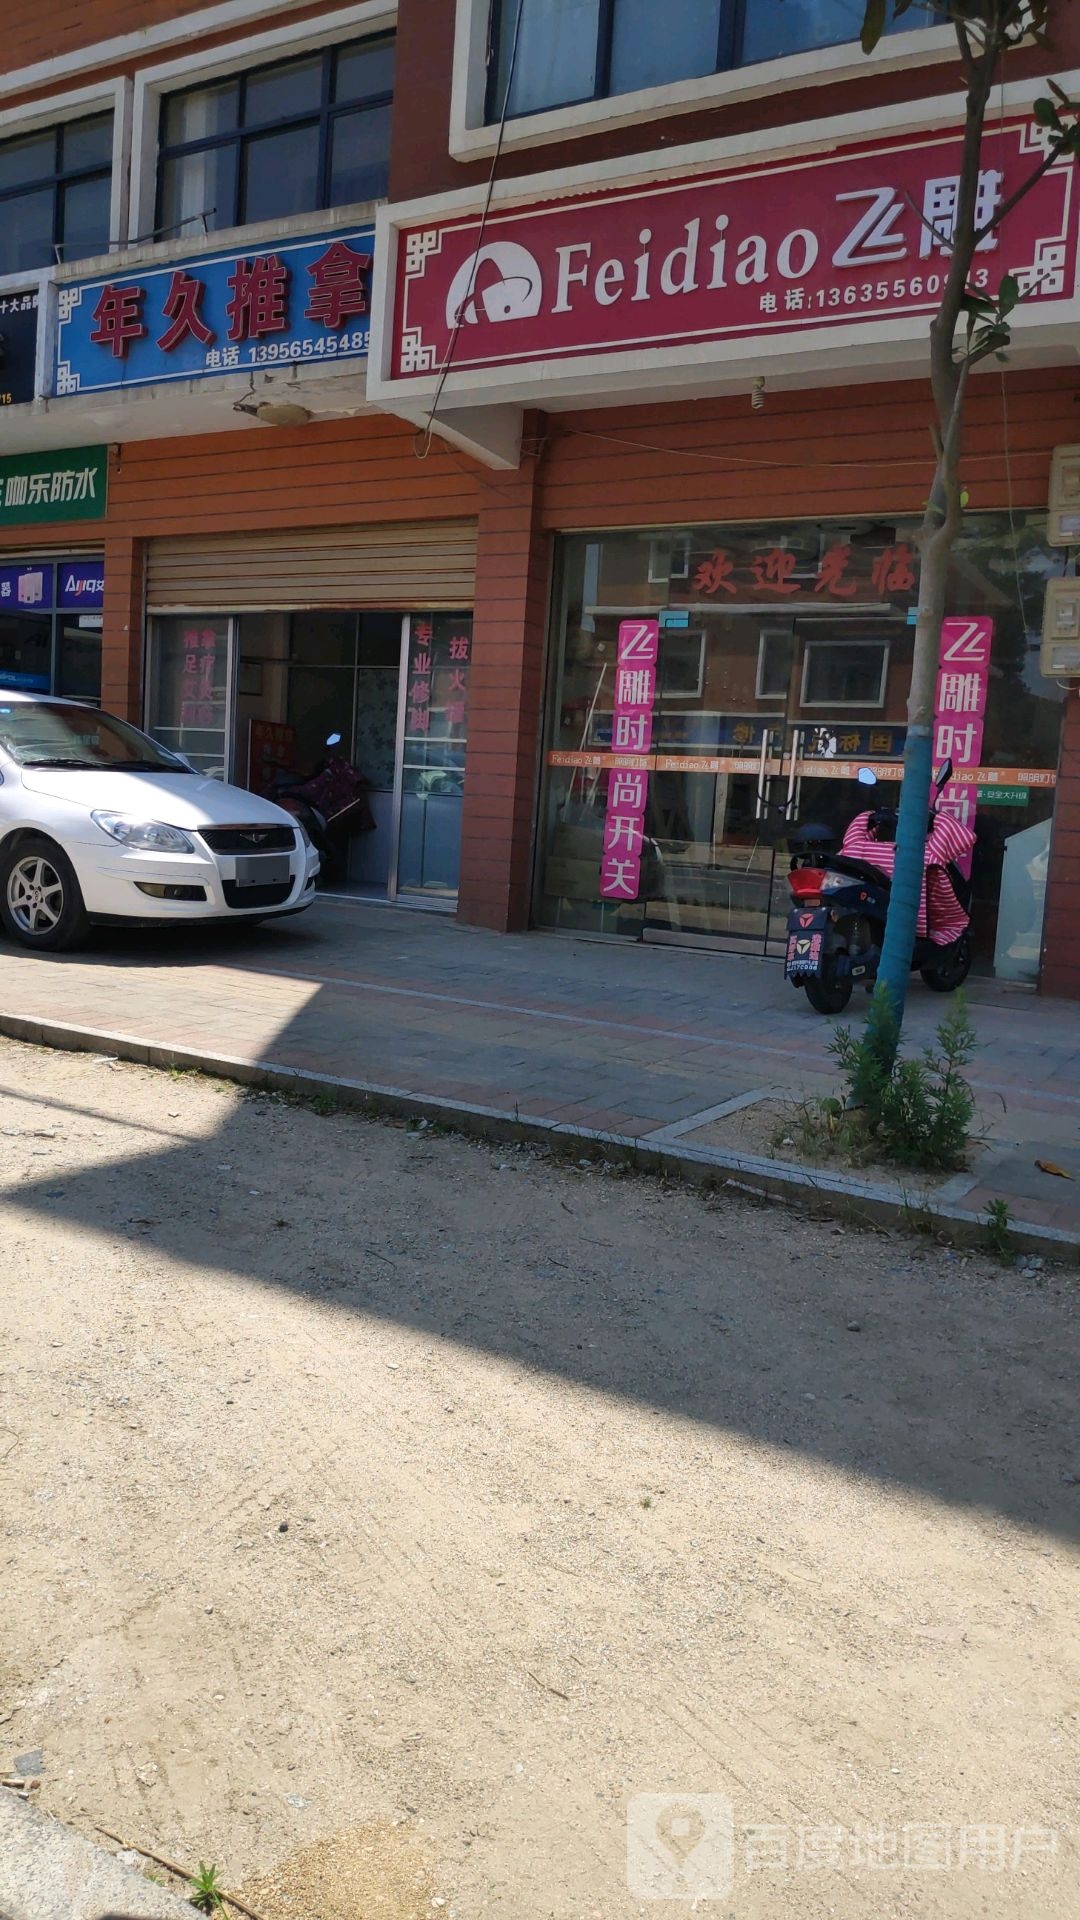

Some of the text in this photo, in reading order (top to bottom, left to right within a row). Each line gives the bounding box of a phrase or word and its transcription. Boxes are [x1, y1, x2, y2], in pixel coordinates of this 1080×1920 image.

[551, 169, 1003, 314] Feidiao 飞雕
[90, 241, 372, 358] 年久推拿
[205, 345, 241, 368] 电话
[0, 467, 98, 507] 咖乐防水
[692, 543, 915, 595] 欢迎光临
[410, 622, 433, 736] 专业修脚
[603, 624, 655, 896] 飞雕时尚开关
